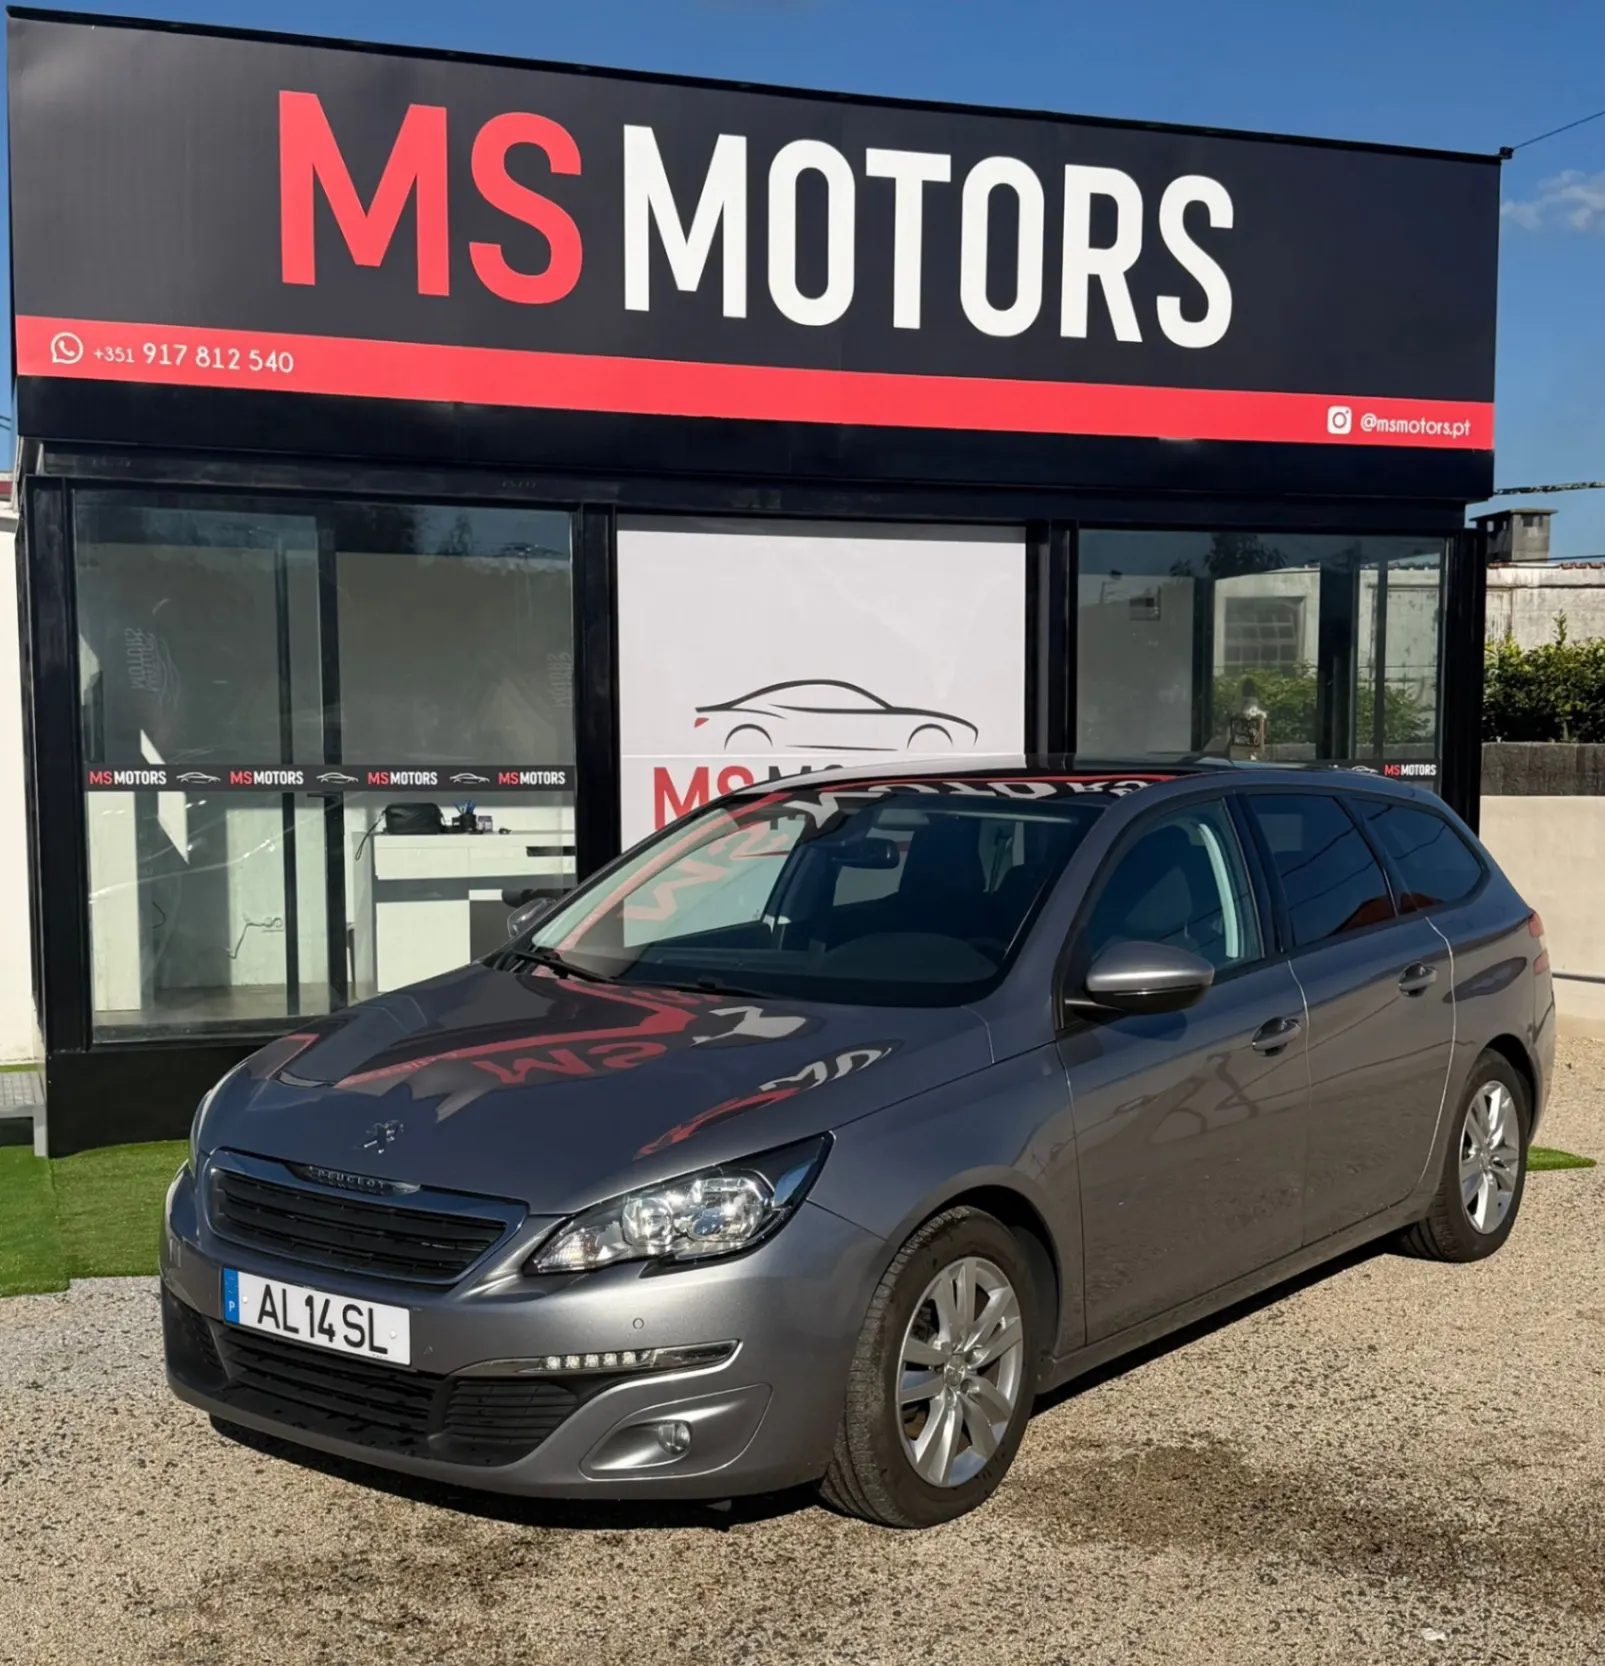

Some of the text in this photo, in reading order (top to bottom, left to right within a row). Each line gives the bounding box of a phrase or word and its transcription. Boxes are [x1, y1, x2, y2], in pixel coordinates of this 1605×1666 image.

[279, 90, 1234, 349] MS MOTORS
[93, 342, 294, 374] +351 917 812 540
[1360, 413, 1471, 439] @msmotors.pt
[114, 770, 167, 785] MOTORS
[253, 770, 304, 785] MOTORS
[390, 771, 438, 785] MOTORS
[519, 771, 566, 785] MOTORS
[1400, 764, 1437, 776] MOTORS
[228, 1300, 236, 1313] P
